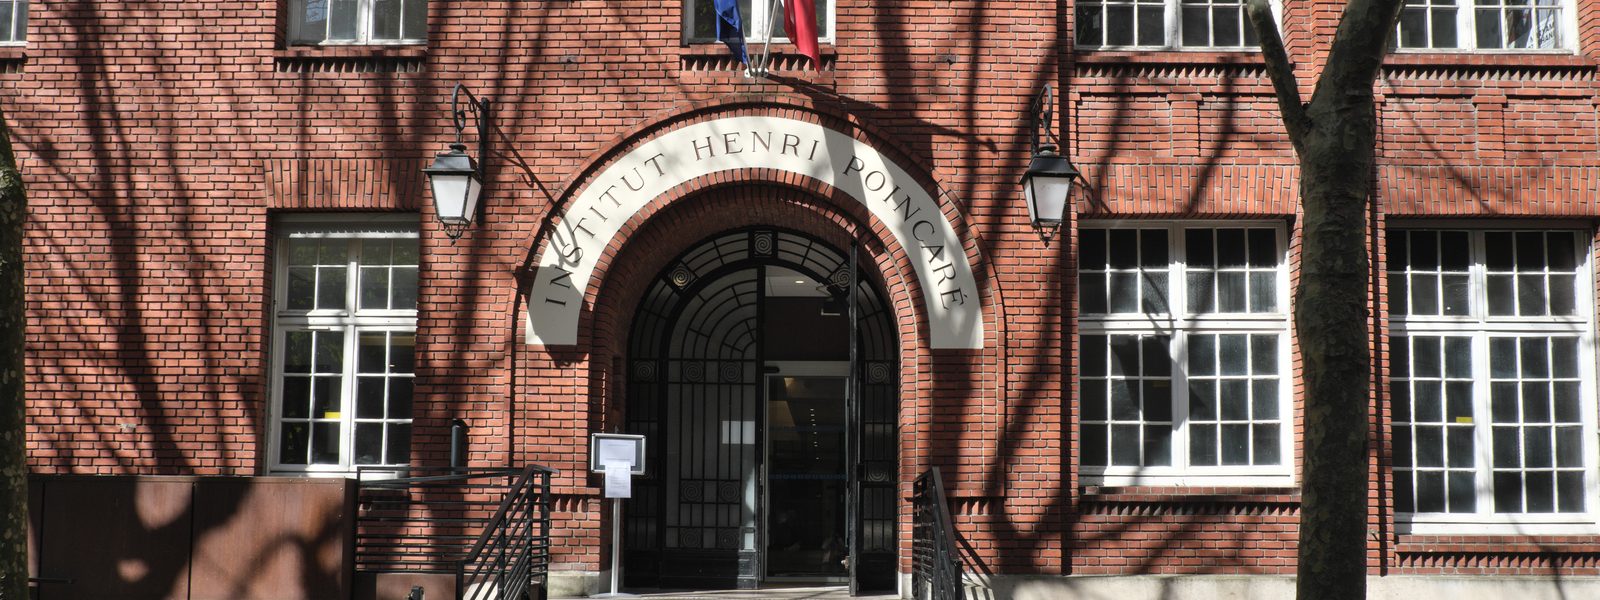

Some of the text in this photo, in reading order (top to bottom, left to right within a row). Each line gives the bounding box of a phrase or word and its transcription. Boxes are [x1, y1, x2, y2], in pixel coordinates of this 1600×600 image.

[545, 130, 969, 311] INSTITUT HENRI POINCARÉ
